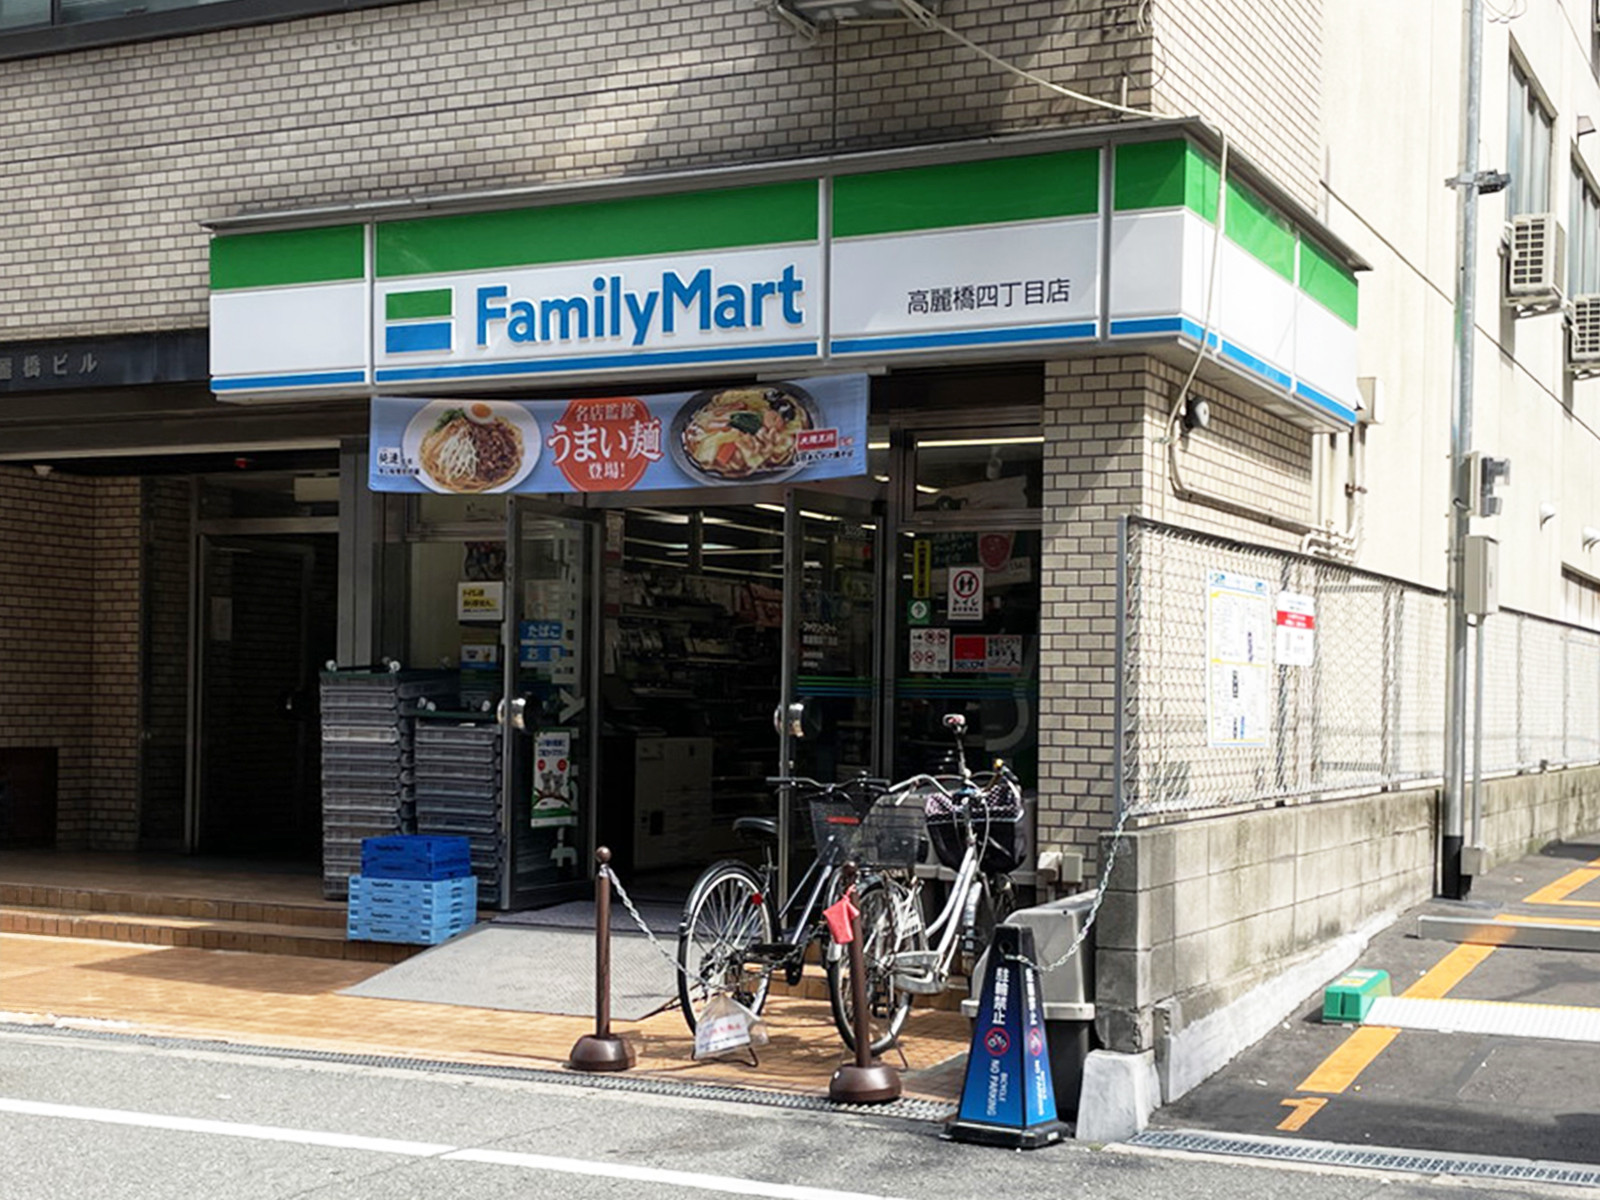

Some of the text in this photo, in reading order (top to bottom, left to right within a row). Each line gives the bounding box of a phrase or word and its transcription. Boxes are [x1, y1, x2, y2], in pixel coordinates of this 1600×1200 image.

[477, 264, 803, 346] FamilyMart
[907, 278, 1070, 315] 高麗橋四丁目店
[547, 419, 662, 464] うまい麺
[527, 624, 561, 638] たばこ
[987, 1075, 999, 1116] PARKING
[1275, 1096, 1329, 1132] 1
